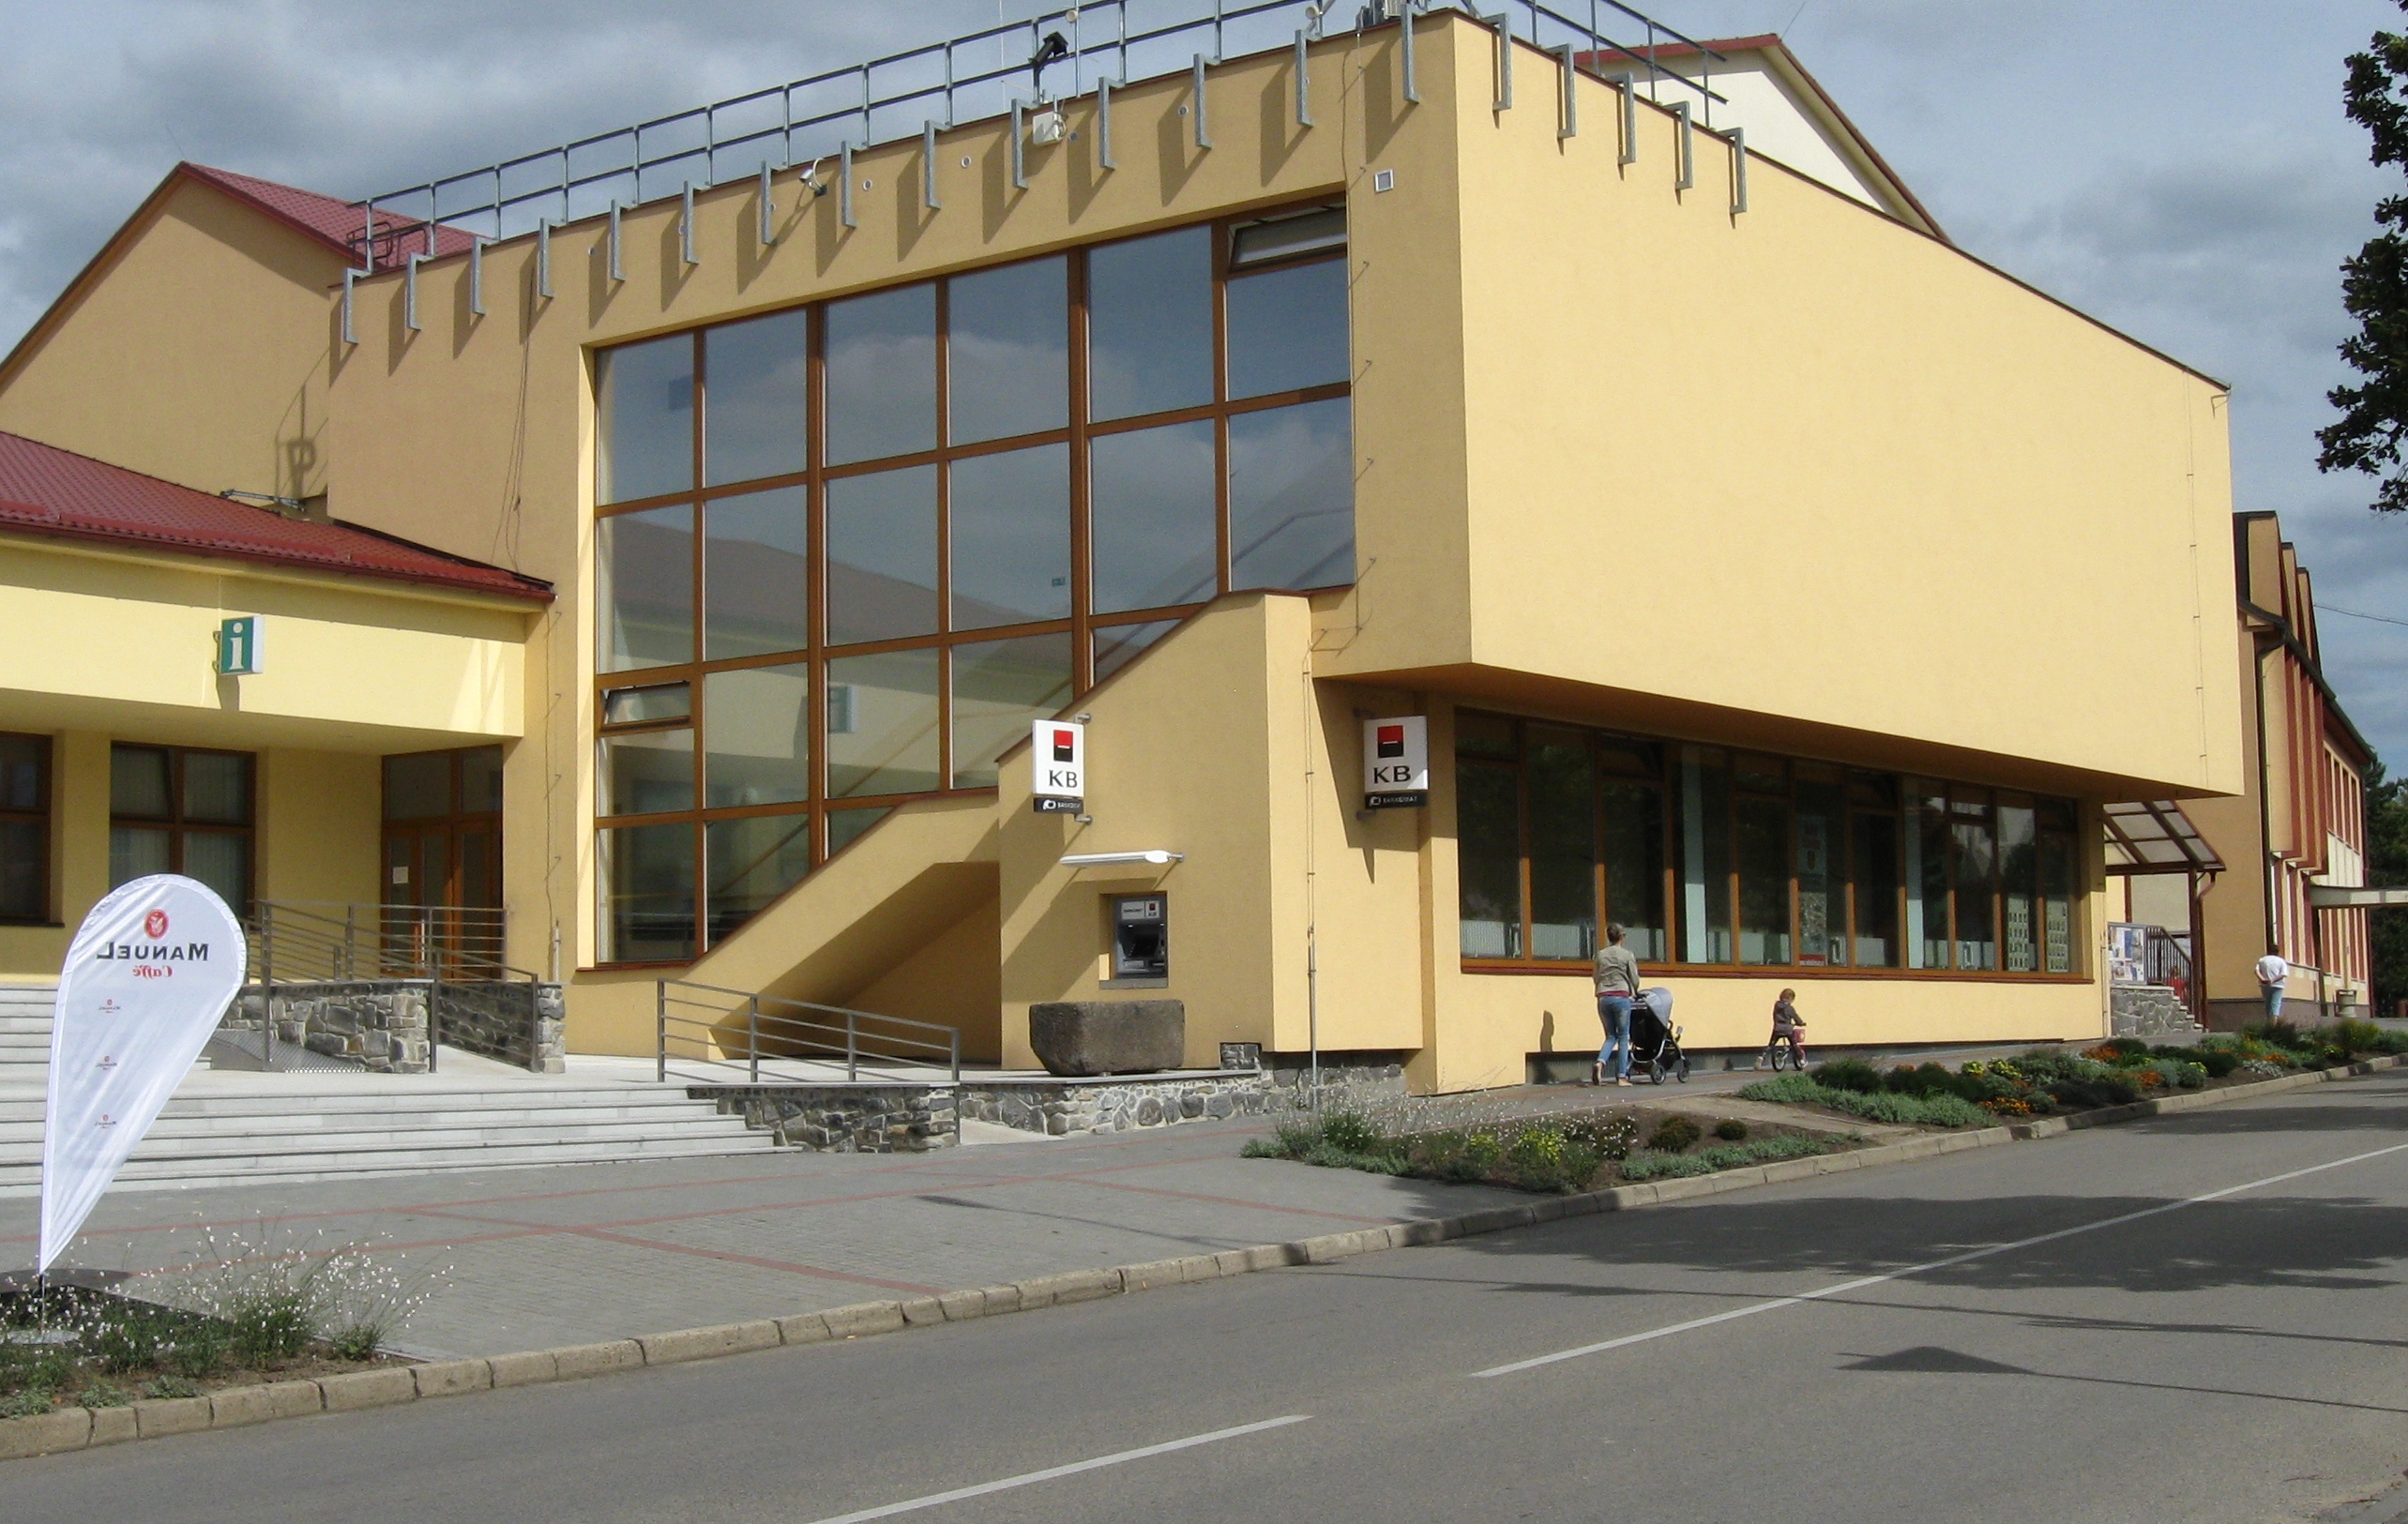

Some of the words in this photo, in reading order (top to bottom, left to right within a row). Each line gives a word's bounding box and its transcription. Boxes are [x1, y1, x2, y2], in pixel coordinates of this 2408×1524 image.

[228, 622, 245, 671] i
[1048, 769, 1078, 788] KB
[1373, 765, 1411, 784] KB
